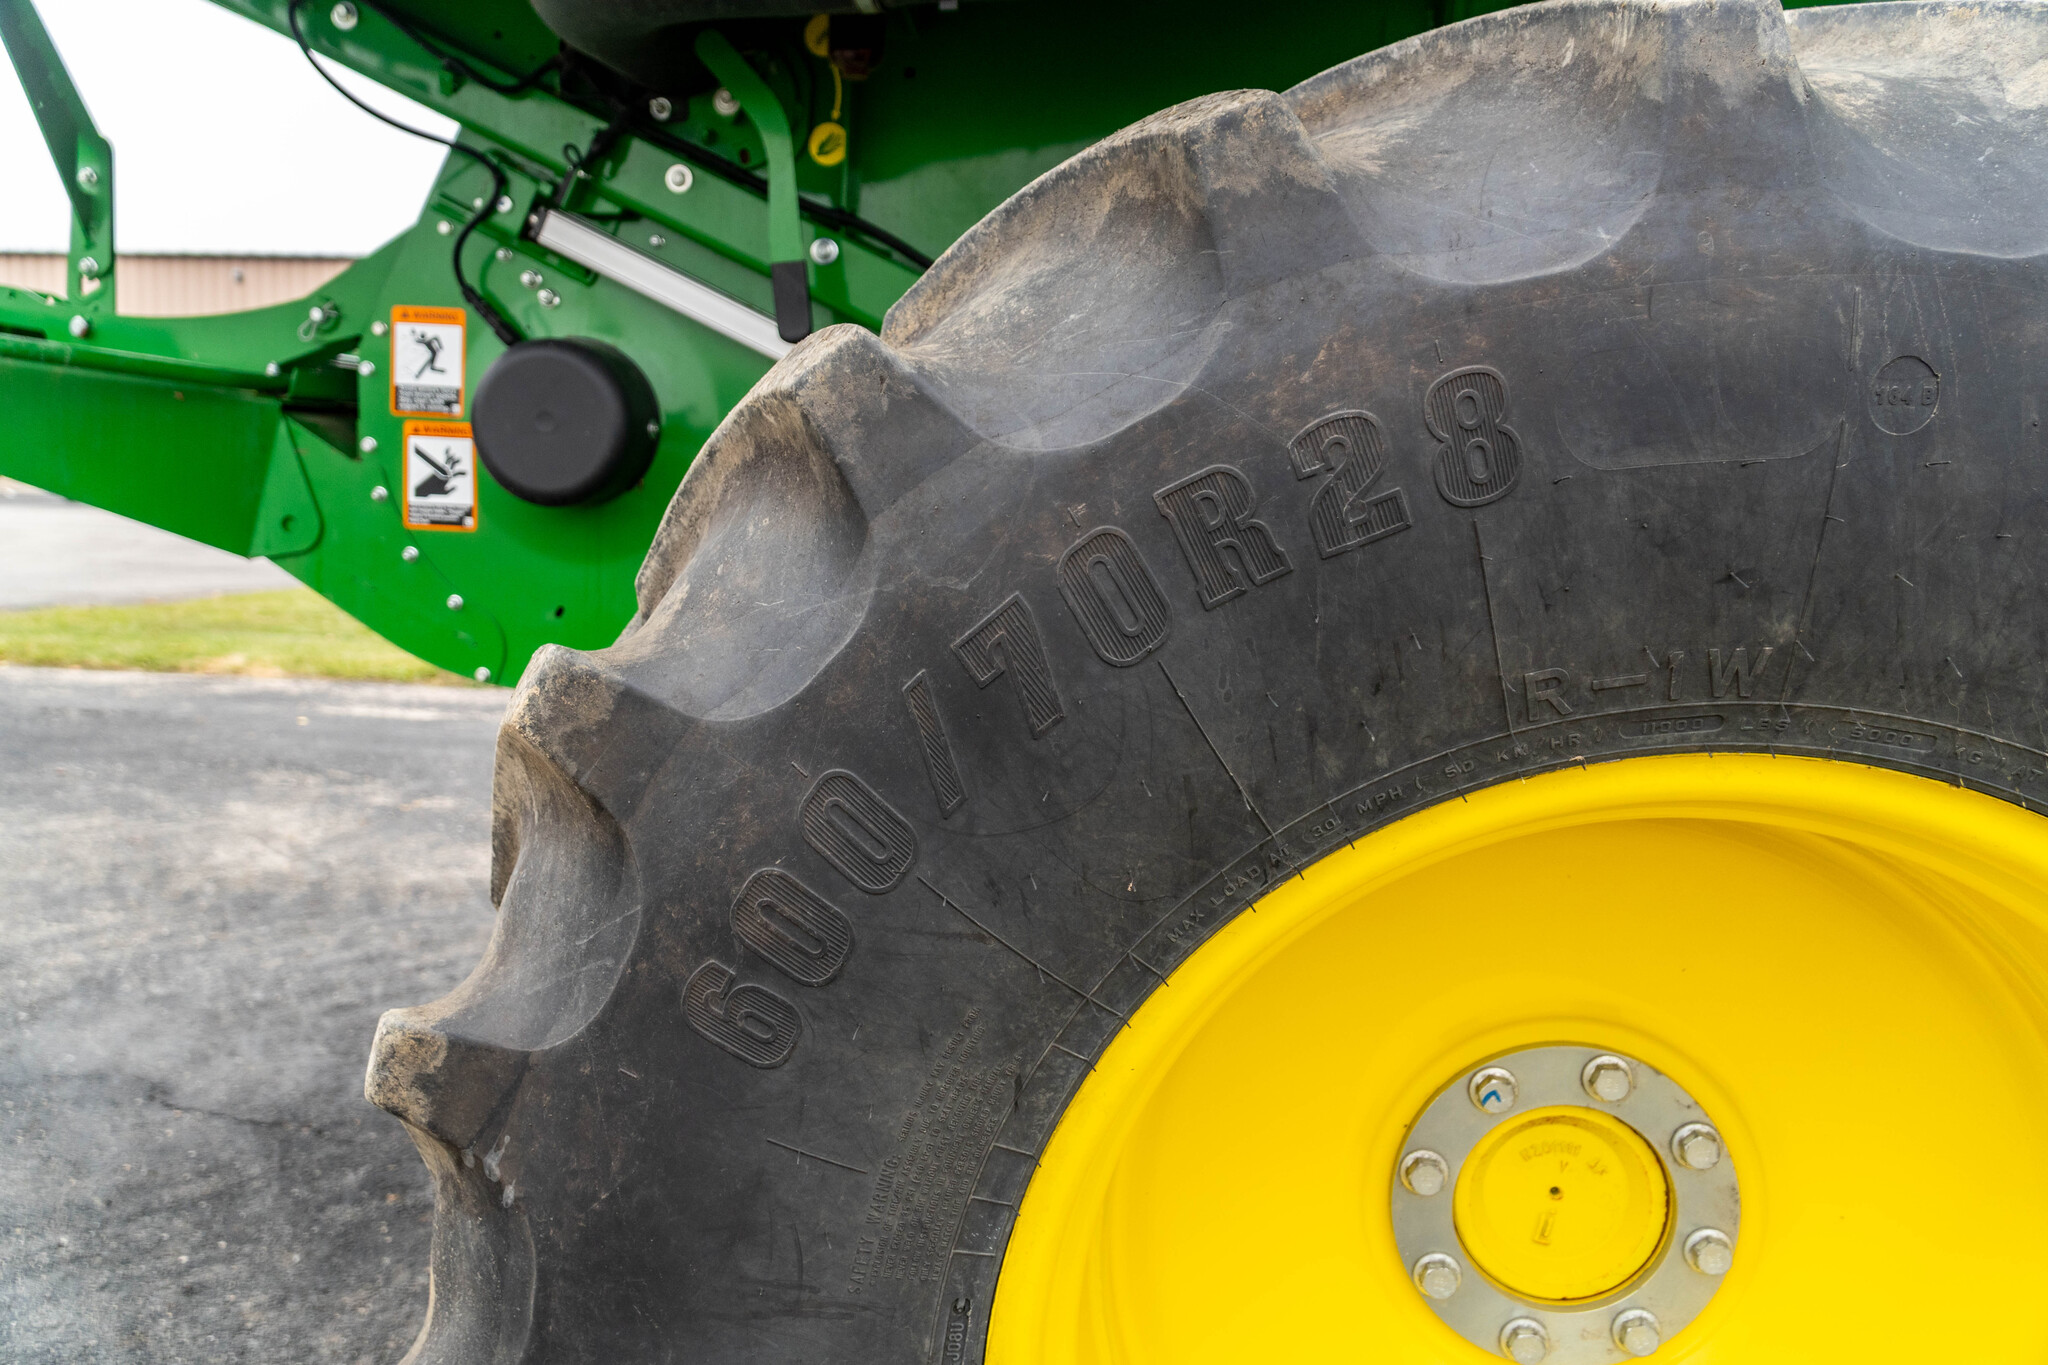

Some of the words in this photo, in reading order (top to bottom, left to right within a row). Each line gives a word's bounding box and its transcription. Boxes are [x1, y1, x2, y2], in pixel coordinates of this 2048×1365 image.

[1163, 905, 1206, 945] MAX
[1207, 861, 1263, 909] LOAD
[1265, 840, 1294, 866] AT
[1353, 782, 1405, 816] MPH
[1739, 714, 1790, 734] LBS
[844, 1235, 875, 1296] SAFETY
[895, 1108, 919, 1144] SERIOUS
[928, 1059, 945, 1079] MAY
[940, 1028, 965, 1061] RESULT
[880, 1220, 894, 1233] OF
[899, 1135, 924, 1177] ASSEMBLY
[917, 1115, 932, 1135] DUE
[933, 1062, 961, 1103] IMPROPER
[880, 1251, 897, 1280] NEVER
